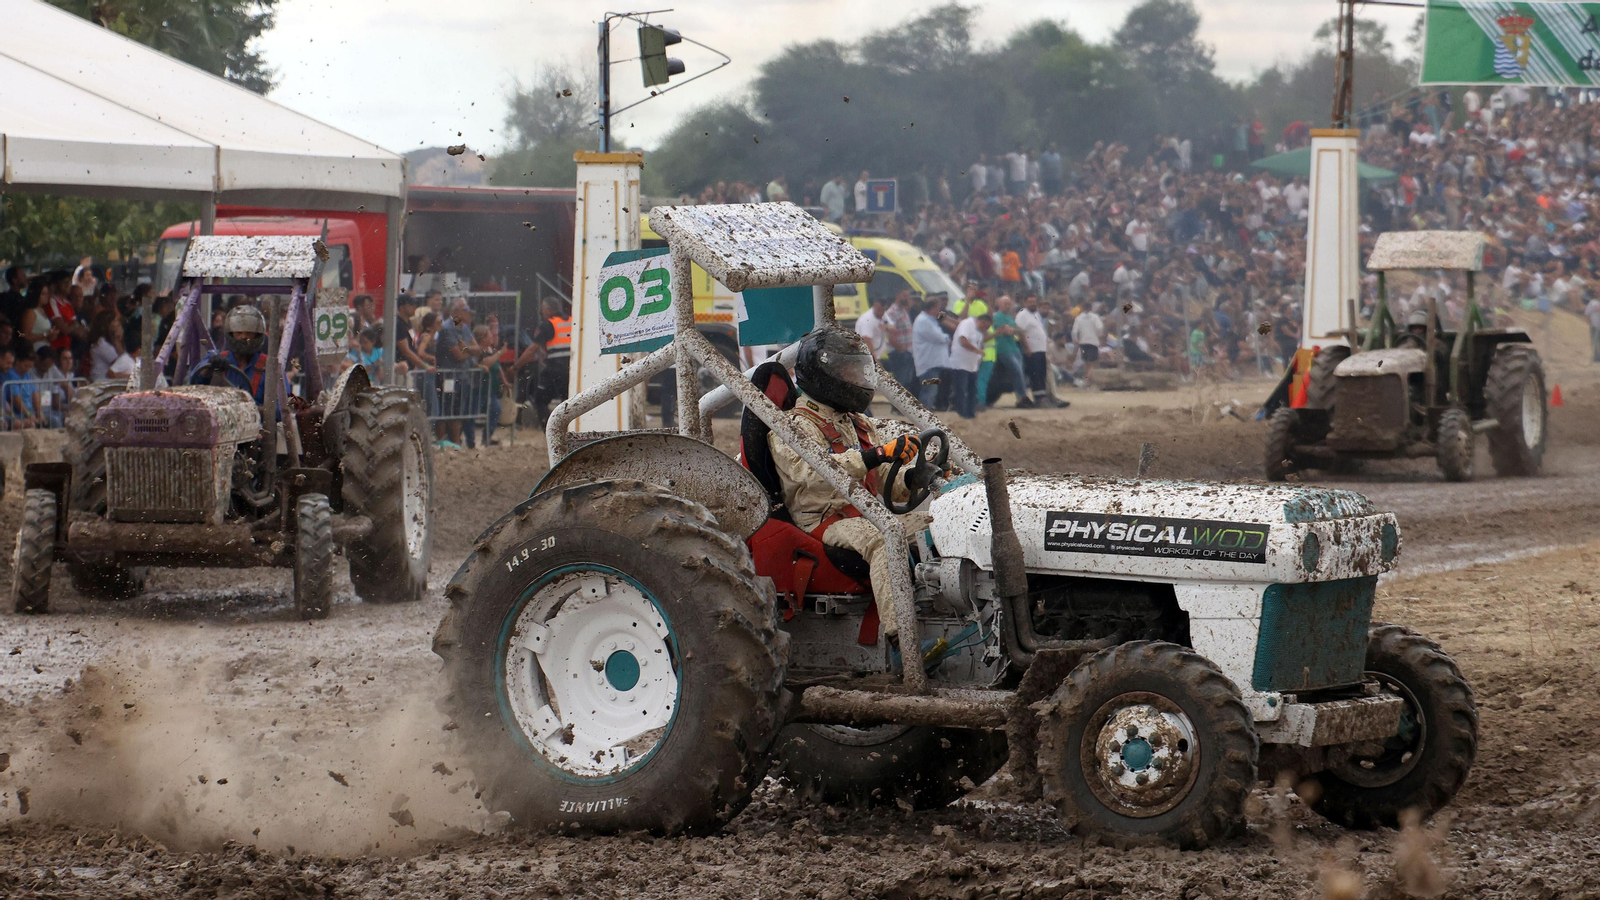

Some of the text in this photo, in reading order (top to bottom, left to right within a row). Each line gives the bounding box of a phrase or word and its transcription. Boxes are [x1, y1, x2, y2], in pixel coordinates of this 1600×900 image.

[600, 268, 672, 322] 03
[317, 312, 348, 341] 09
[1047, 541, 1105, 549] www.physicalwod.com
[1153, 547, 1259, 560] WORKOUT OF THE DAY
[559, 797, 622, 814] ALLIANCE
